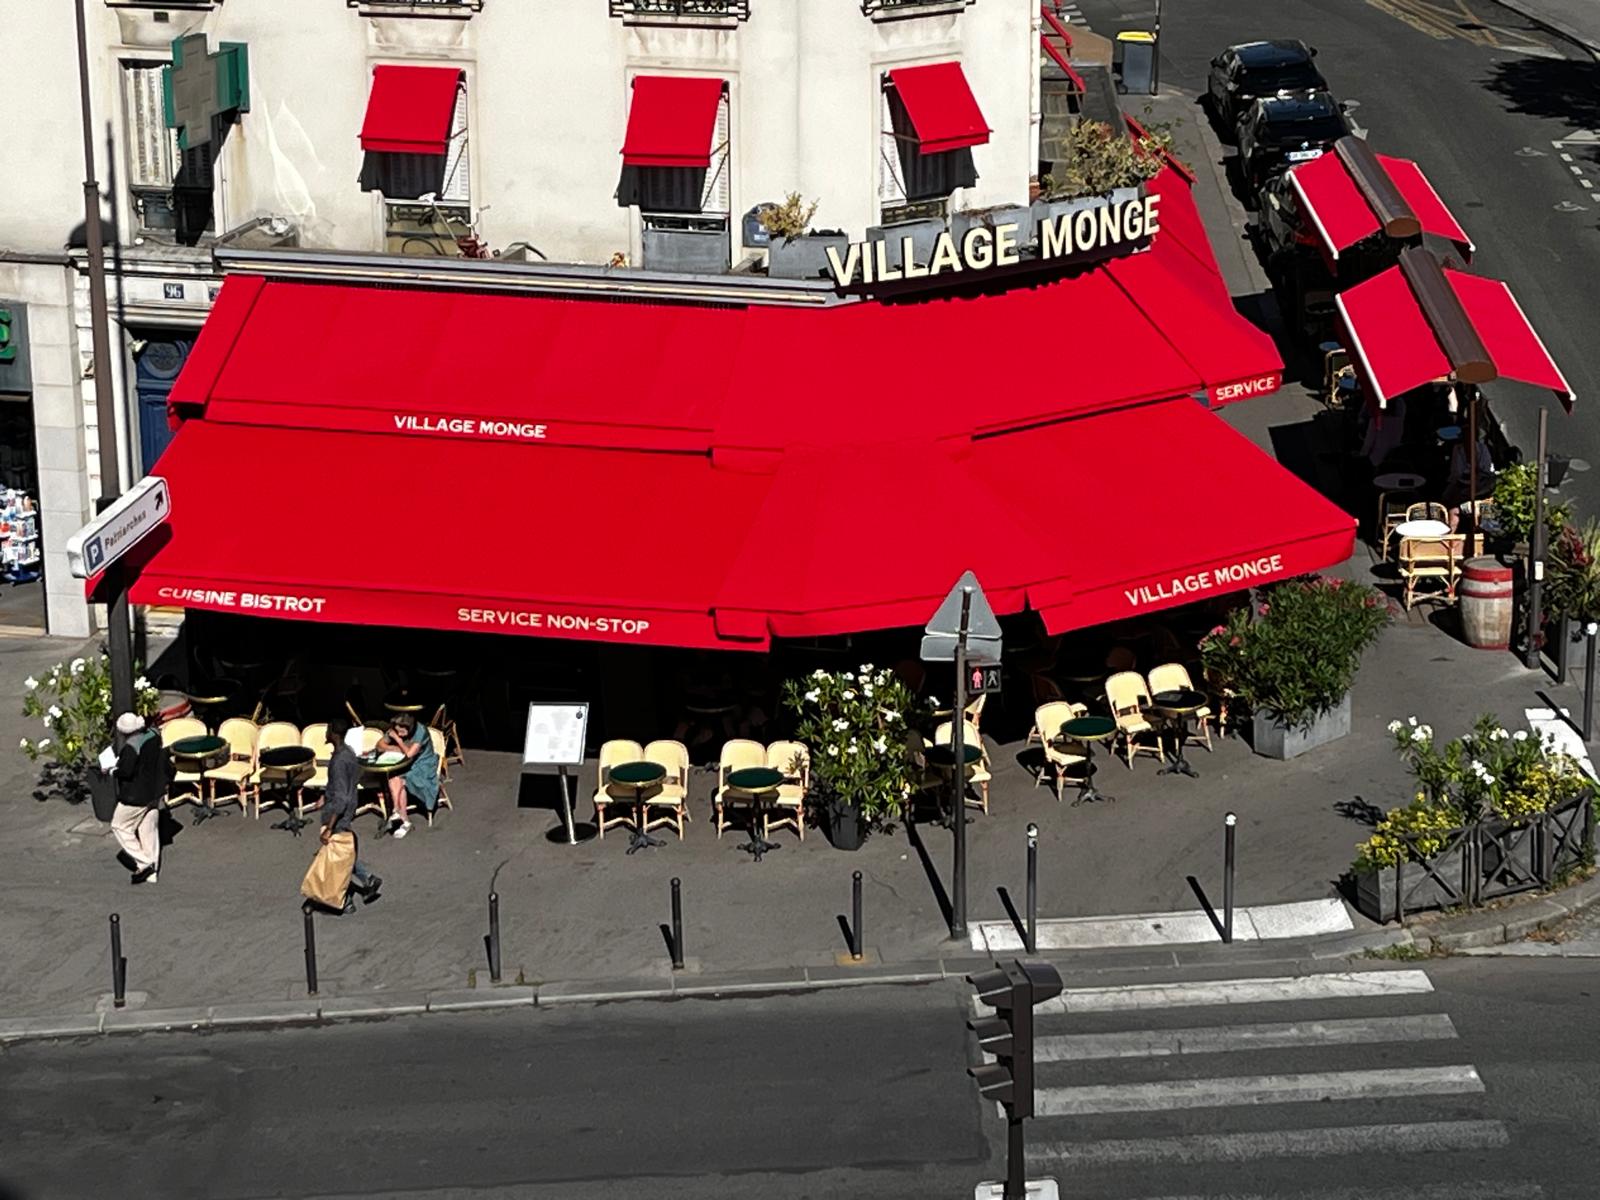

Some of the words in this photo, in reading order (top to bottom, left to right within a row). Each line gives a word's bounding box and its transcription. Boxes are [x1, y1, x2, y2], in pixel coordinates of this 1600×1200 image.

[825, 222, 1020, 287] VILLAGE
[1041, 194, 1162, 260] MONGE
[165, 283, 182, 298] 96
[1215, 376, 1275, 401] SERVICE
[393, 414, 475, 434] VILLAGE
[479, 420, 547, 438] MONGE
[1124, 572, 1213, 606] VILLAGE
[1214, 554, 1284, 585] MONGE
[158, 587, 236, 606] CUISINE
[240, 593, 326, 613] BISTROT
[457, 608, 542, 627] SERVICE
[547, 614, 650, 634] NON-STOP
